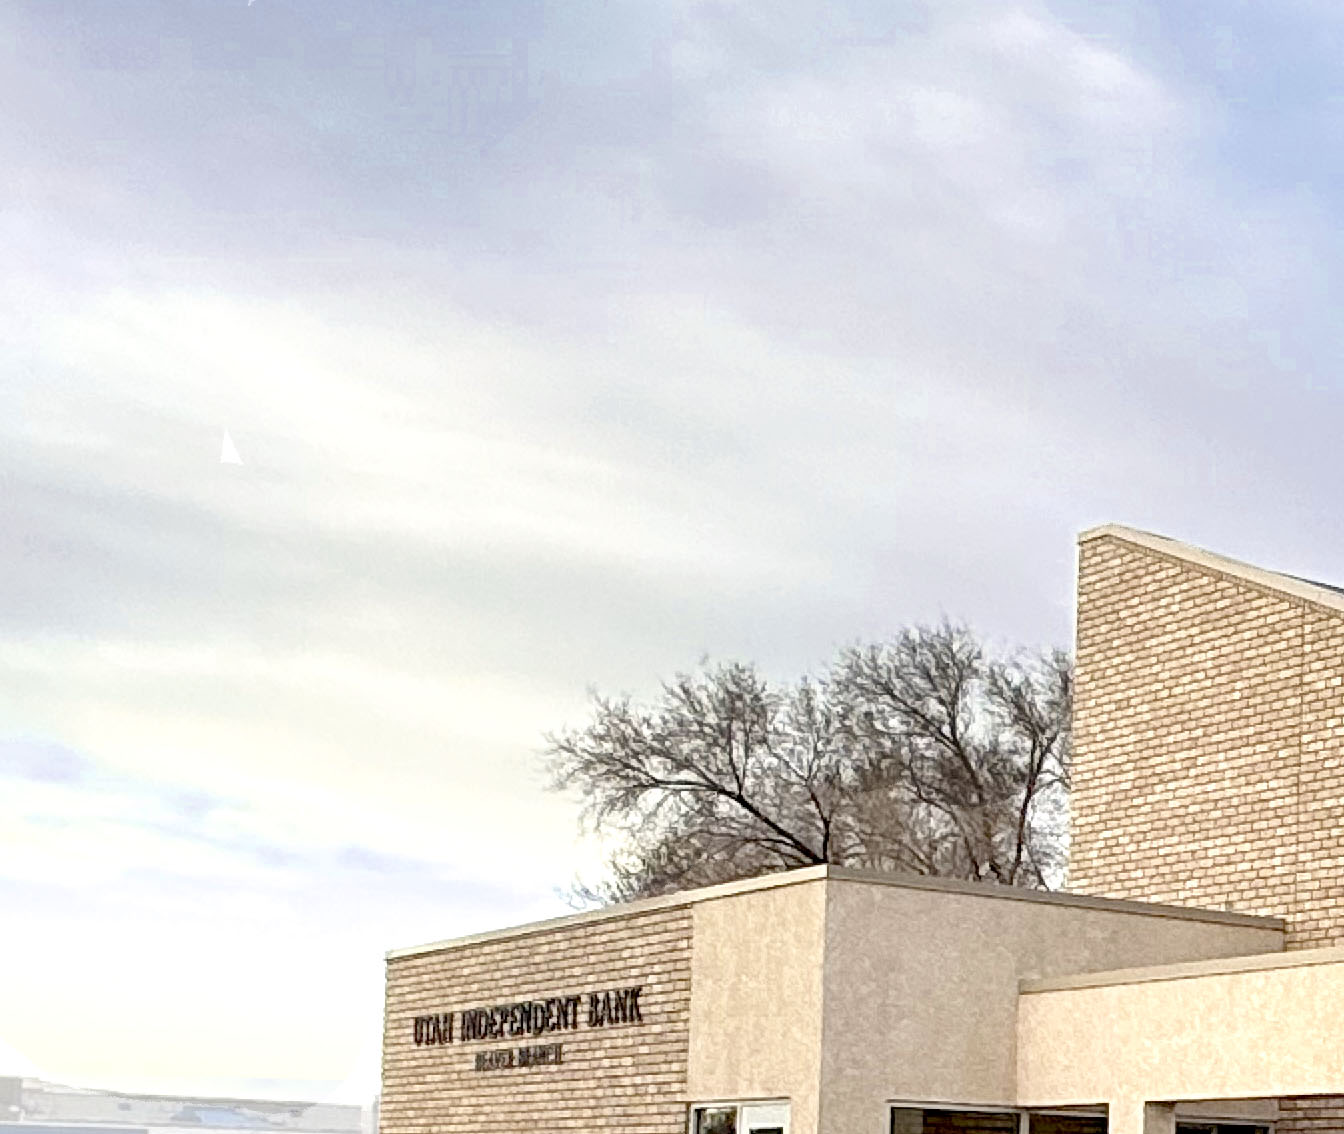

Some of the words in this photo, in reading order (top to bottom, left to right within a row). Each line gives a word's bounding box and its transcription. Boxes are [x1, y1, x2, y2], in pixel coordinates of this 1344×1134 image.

[414, 1013, 454, 1046] UTAH
[460, 996, 581, 1042] INDEPENDENT
[588, 985, 643, 1027] BANK
